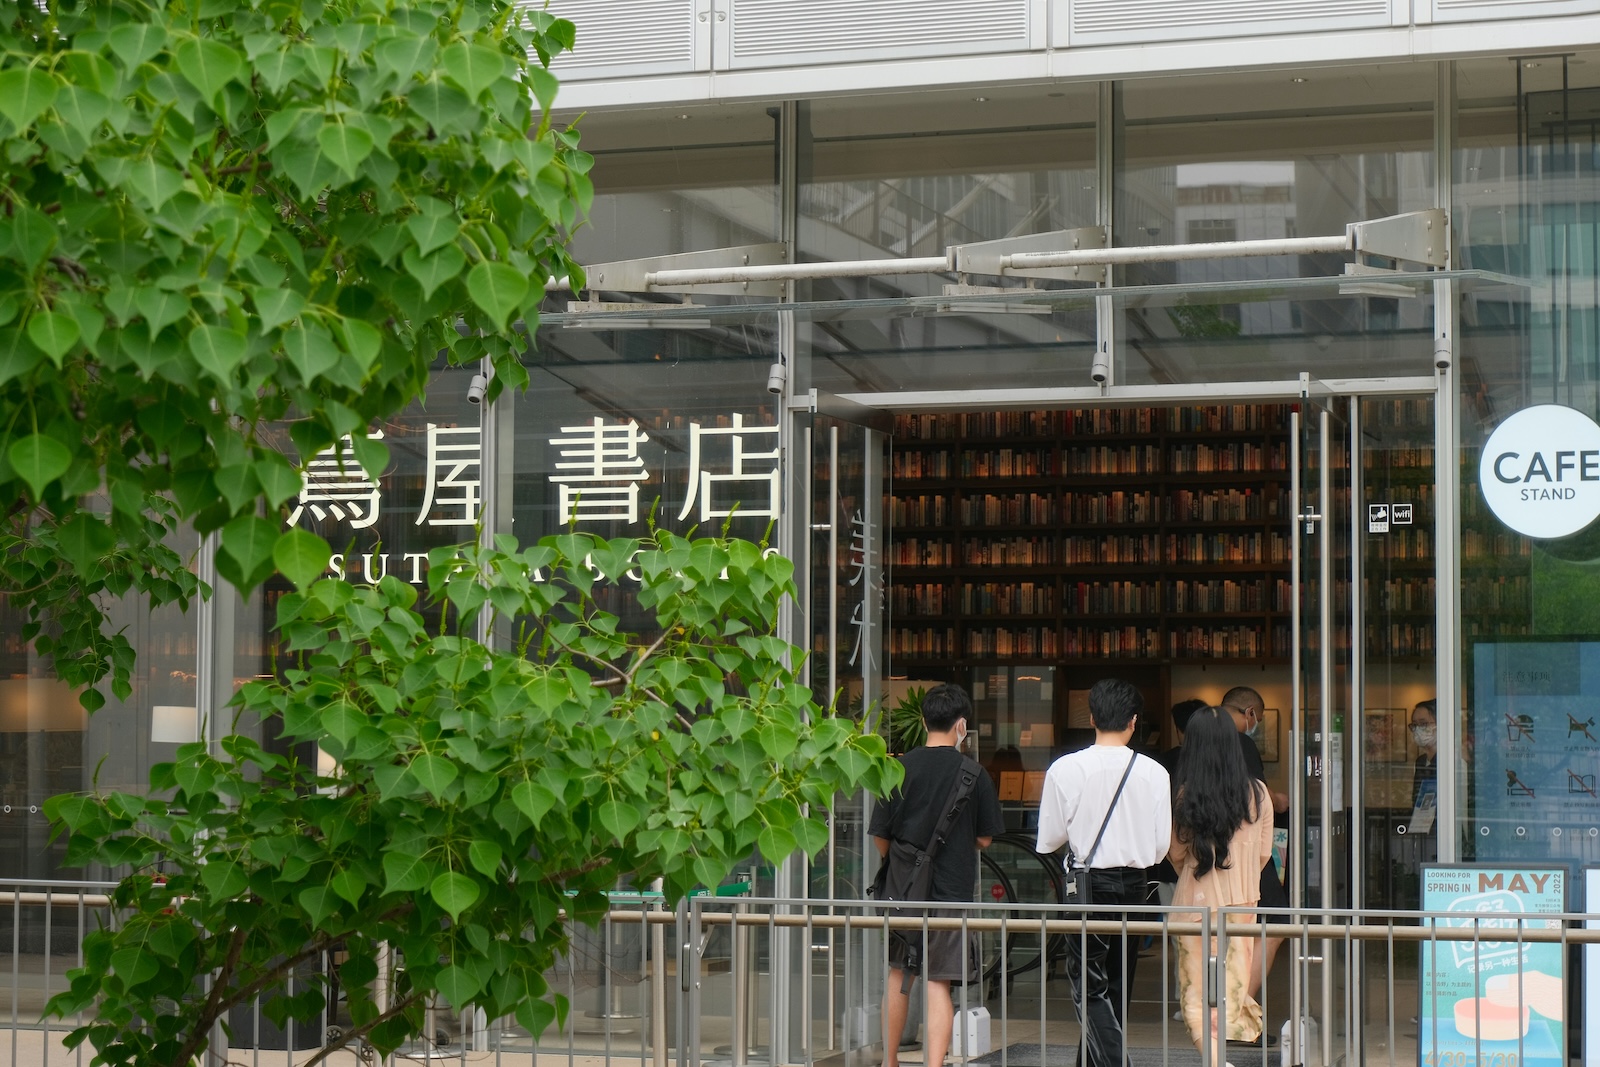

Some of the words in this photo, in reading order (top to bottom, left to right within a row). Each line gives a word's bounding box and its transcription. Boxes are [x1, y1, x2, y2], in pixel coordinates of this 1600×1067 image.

[1493, 450, 1600, 485] CAFE
[1520, 487, 1576, 501] STAND
[1394, 509, 1411, 519] wifi
[1427, 871, 1457, 879] LOOKING
[1427, 882, 1460, 893] SPRING
[1461, 883, 1471, 893] IN
[1478, 872, 1552, 894] MAY
[1553, 873, 1561, 894] 2022
